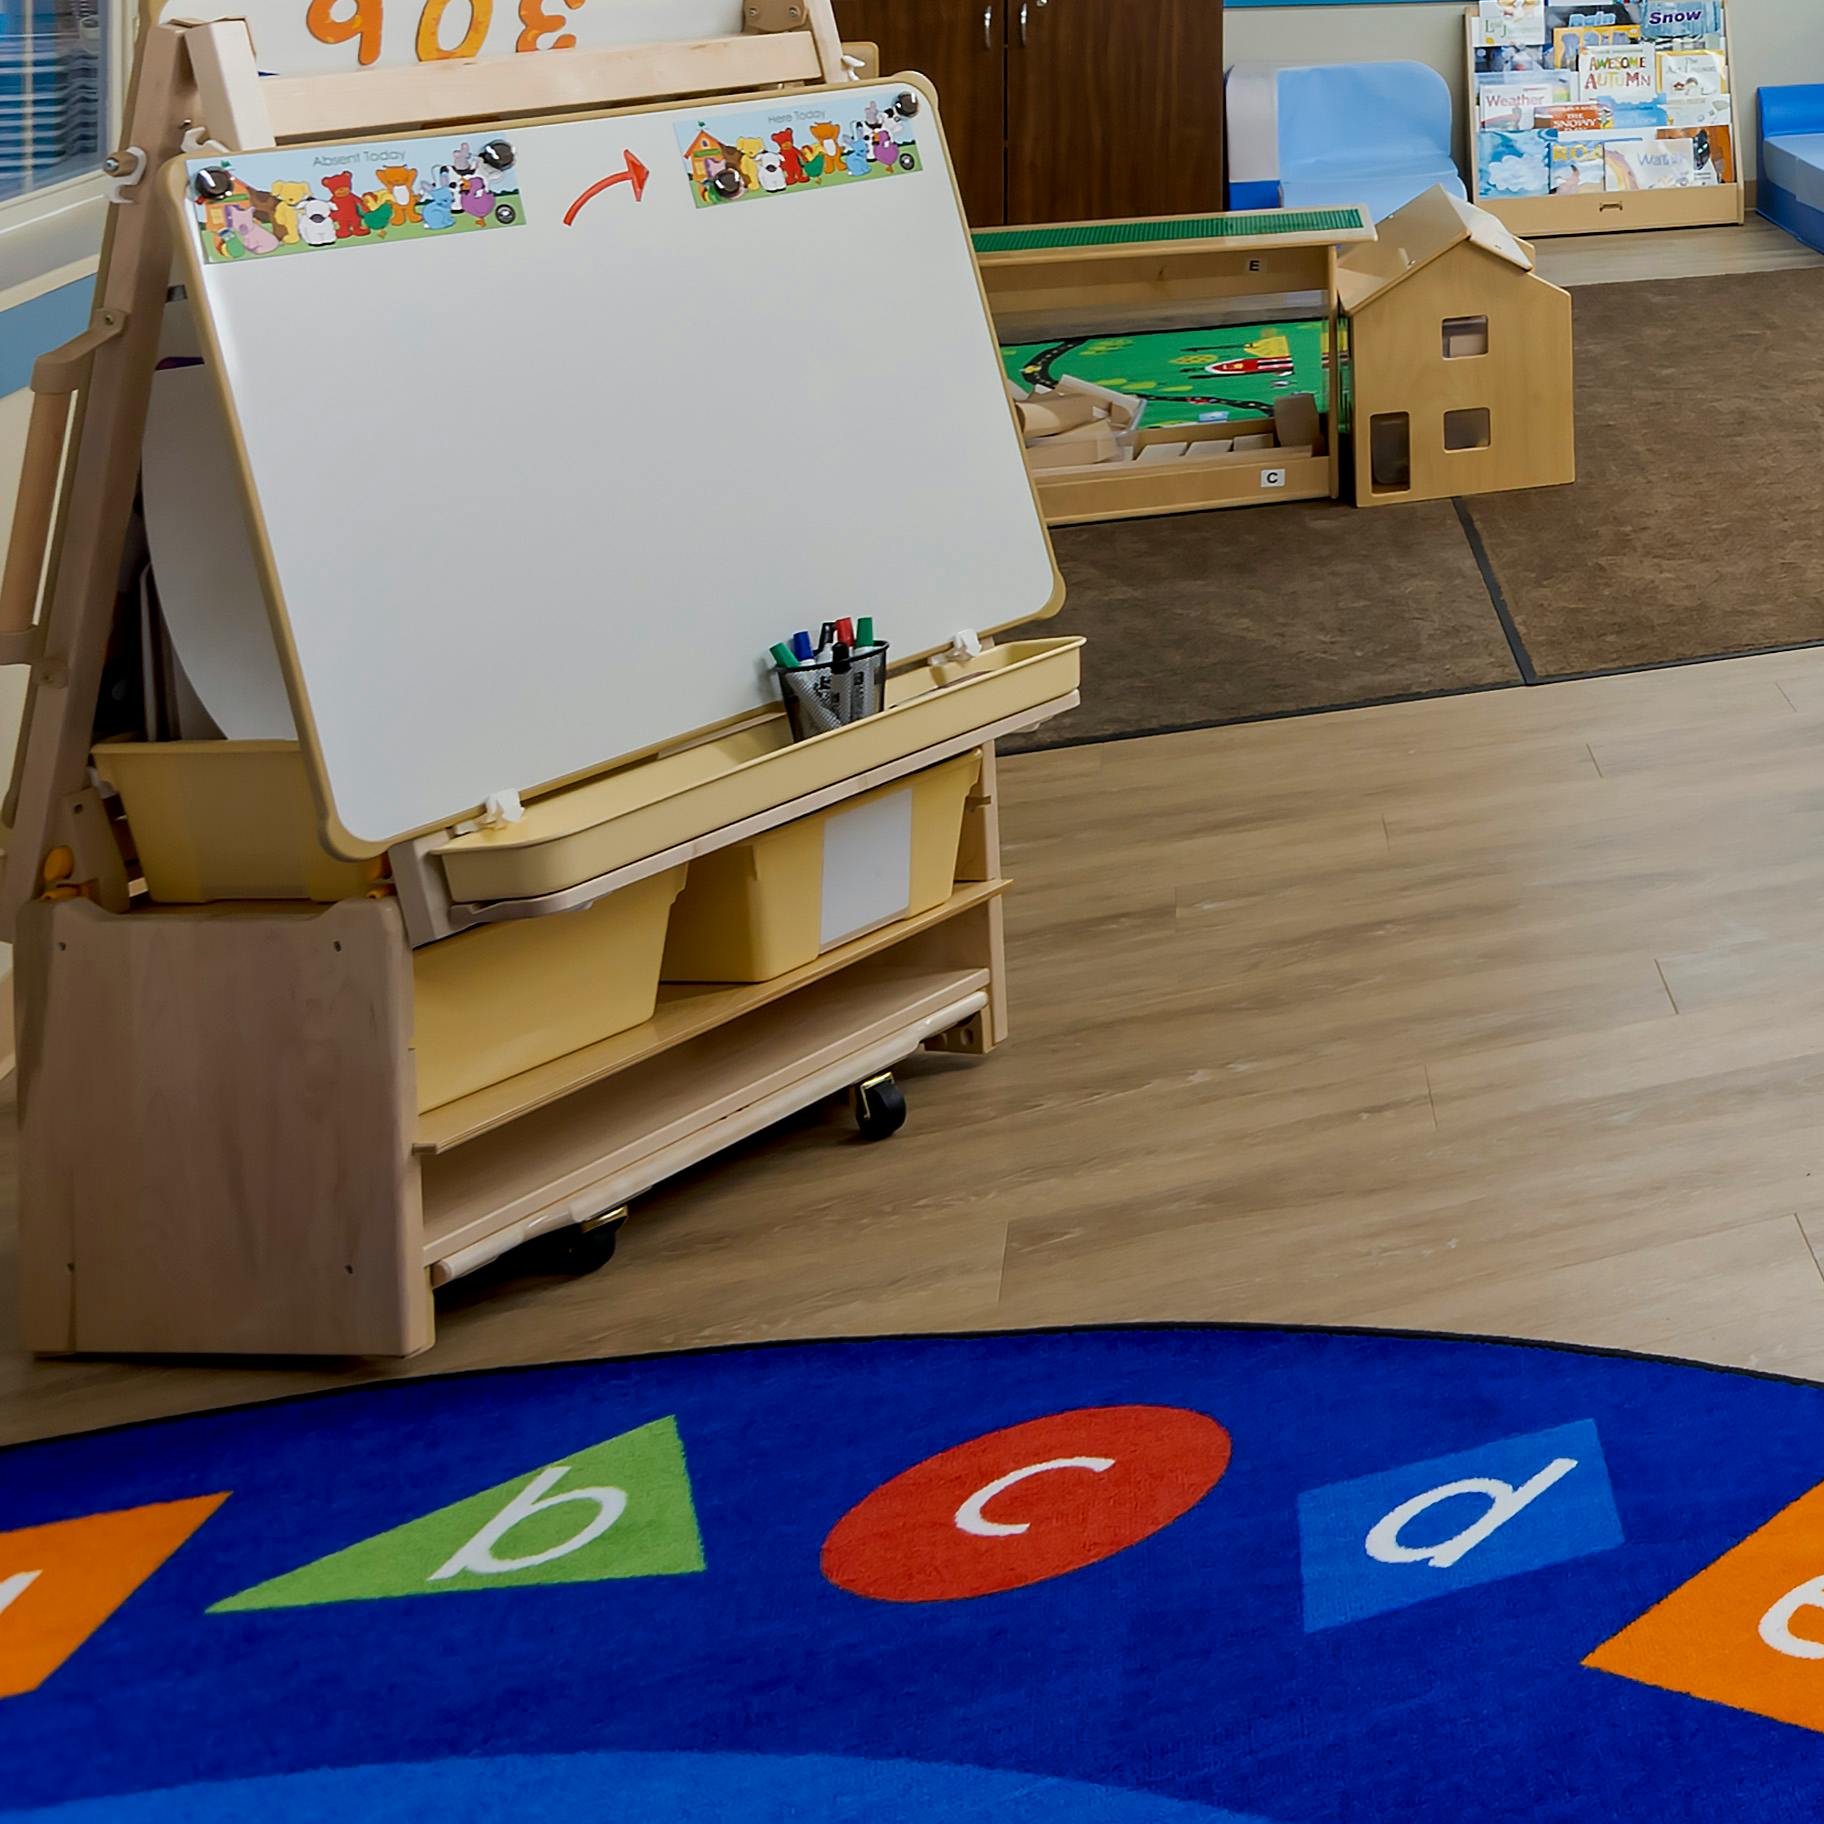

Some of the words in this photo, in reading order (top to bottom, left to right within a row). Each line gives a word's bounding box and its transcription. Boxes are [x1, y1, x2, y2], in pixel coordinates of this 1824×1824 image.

[1649, 11, 1702, 25] Snow
[1589, 56, 1646, 71] AWESOME
[1585, 72, 1651, 90] AUTUMN
[1486, 93, 1545, 107] Weather
[767, 112, 793, 124] Here
[794, 109, 826, 121] Today
[312, 152, 361, 168] Absent
[362, 150, 407, 165] Today
[1249, 259, 1260, 272] E
[1267, 471, 1279, 484] C
[427, 1466, 628, 1582] b
[954, 1456, 1116, 1536] c
[1365, 1456, 1579, 1567] d
